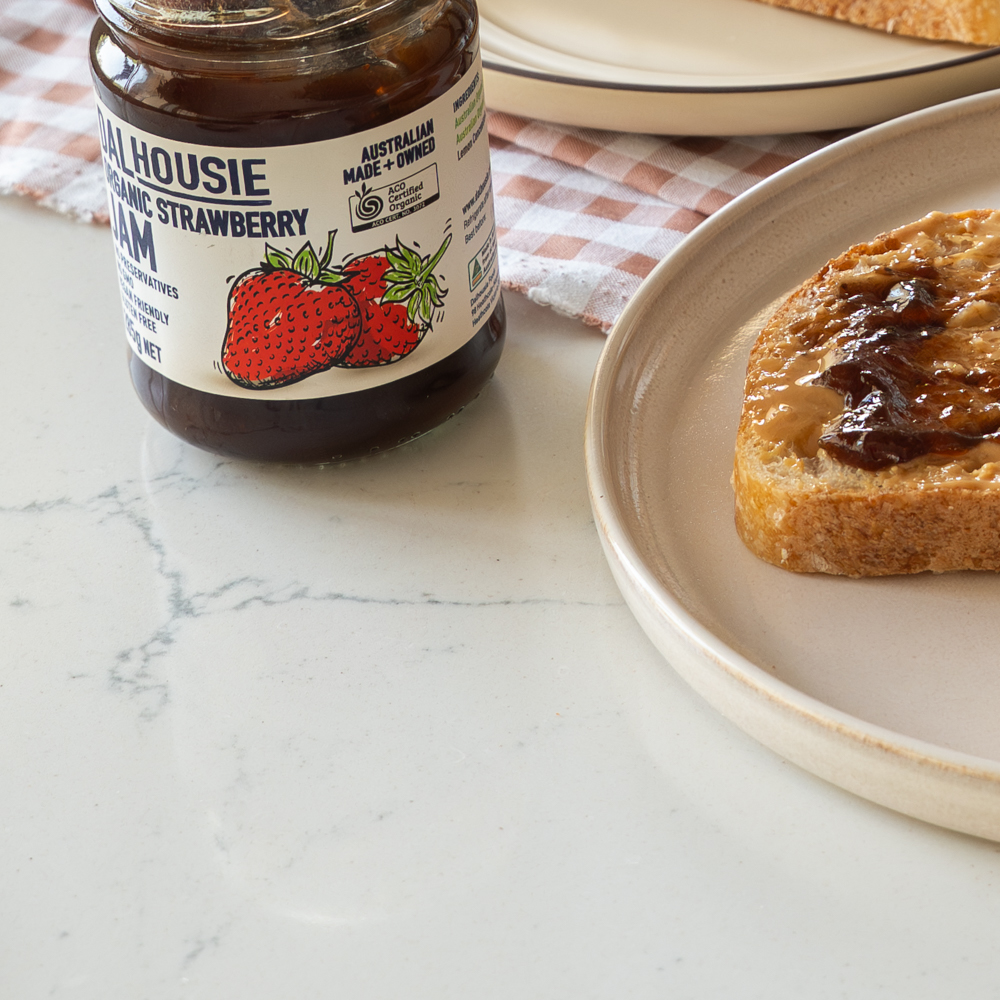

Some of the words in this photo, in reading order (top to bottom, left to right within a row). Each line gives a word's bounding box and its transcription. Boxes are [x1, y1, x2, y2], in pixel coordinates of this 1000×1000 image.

[97, 103, 270, 197] DALHOUSIE
[361, 117, 434, 164] AUSTRALIAN
[343, 159, 382, 186] MADE
[396, 135, 436, 169] OWNED
[387, 181, 406, 196] ACO
[388, 180, 424, 204] Certified
[388, 192, 422, 212] Organic
[110, 189, 158, 273] JAM
[155, 196, 310, 239] STRAWBERRY
[371, 218, 385, 228] ACO
[120, 252, 180, 300] PRESERVATIVES
[133, 293, 170, 327] FRIENDLY
[138, 311, 158, 335] FREE
[142, 336, 162, 364] NET
